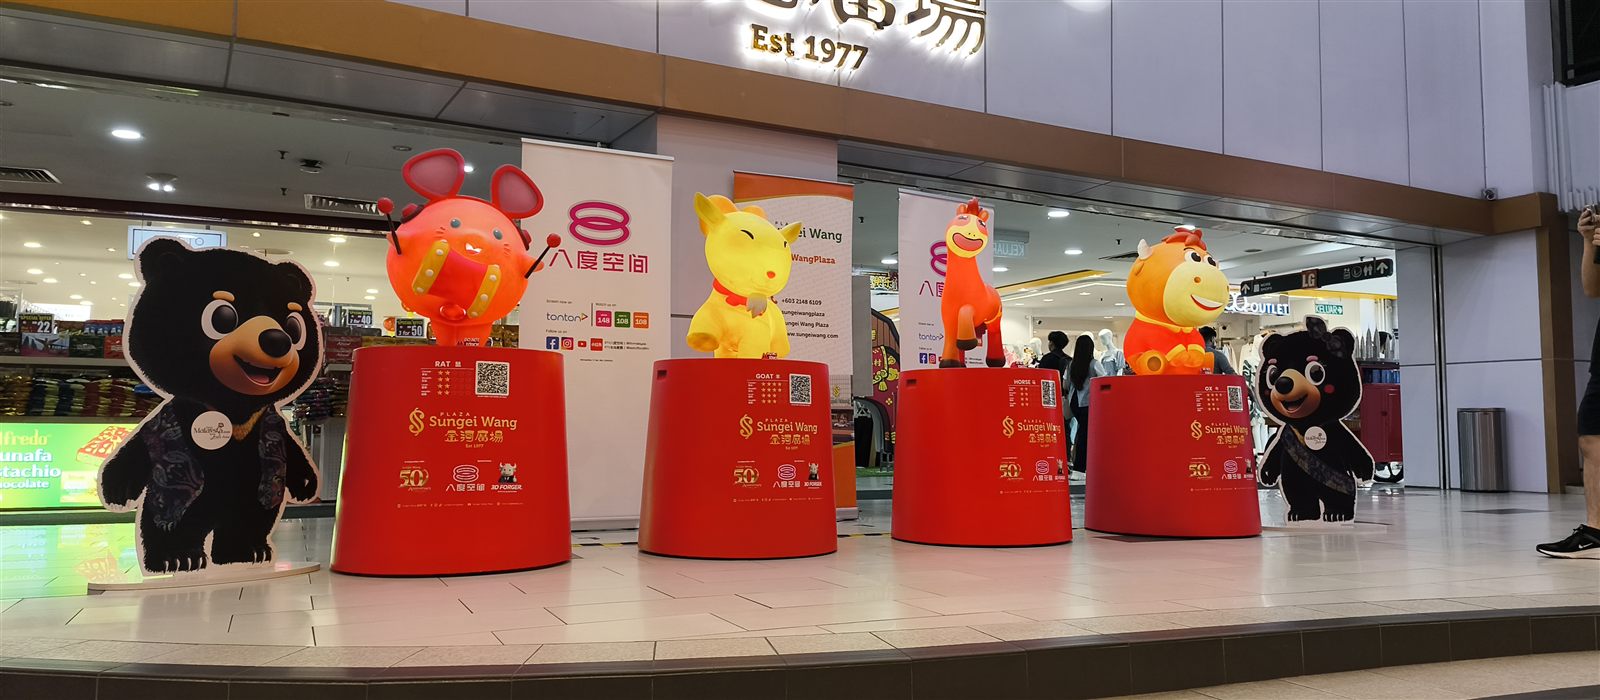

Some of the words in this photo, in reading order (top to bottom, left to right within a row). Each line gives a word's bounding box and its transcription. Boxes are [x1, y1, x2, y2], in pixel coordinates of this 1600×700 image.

[751, 24, 795, 57] Est
[804, 36, 869, 71] 1977
[809, 228, 842, 244] Wang
[549, 249, 648, 273] 八度空间
[1302, 273, 1315, 287] LG
[1250, 303, 1289, 315] OUTLET
[1316, 304, 1338, 314] KELUAR
[37, 320, 51, 333] 22
[411, 325, 423, 336] 50
[429, 415, 478, 429] Sungei
[481, 416, 518, 430] Wang
[757, 421, 793, 434] Sungei
[794, 421, 818, 435] Wang
[1017, 422, 1045, 433] Sungei
[1205, 425, 1232, 435] Sungei
[0, 429, 49, 446] lfredo
[0, 448, 52, 462] unafa
[0, 464, 62, 478] tachio
[733, 468, 756, 484] 50
[1000, 463, 1018, 478] 50
[1189, 463, 1206, 478] 50
[0, 479, 49, 489] ocolate
[399, 469, 424, 488] 50
